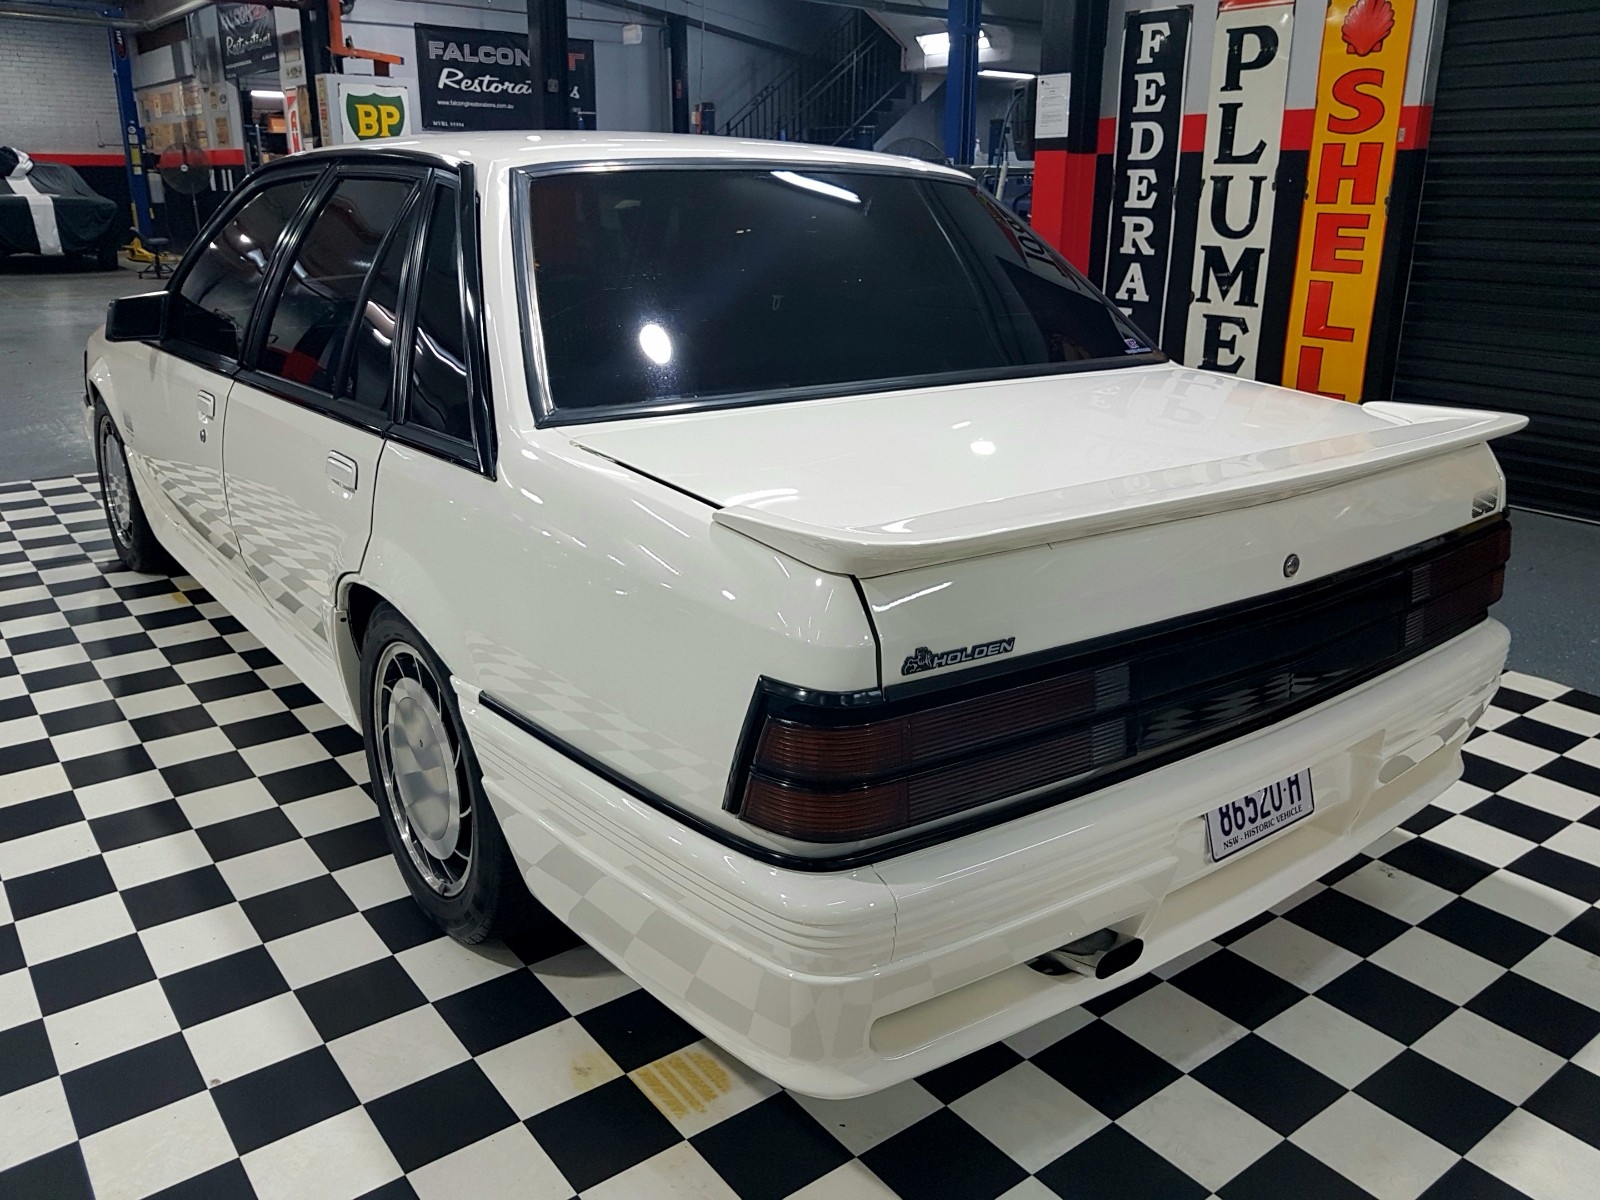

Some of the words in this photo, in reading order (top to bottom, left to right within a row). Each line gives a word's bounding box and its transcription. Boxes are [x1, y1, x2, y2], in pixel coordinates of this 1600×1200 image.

[428, 40, 531, 67] FALCON
[355, 103, 400, 137] BP
[1115, 22, 1170, 318] FEDERA
[1196, 25, 1279, 375] PLUME
[933, 639, 1015, 668] HOLDEN
[1223, 835, 1239, 850] NSW
[1243, 817, 1276, 840] HISTORIC
[1275, 804, 1303, 824] VEHICLE
